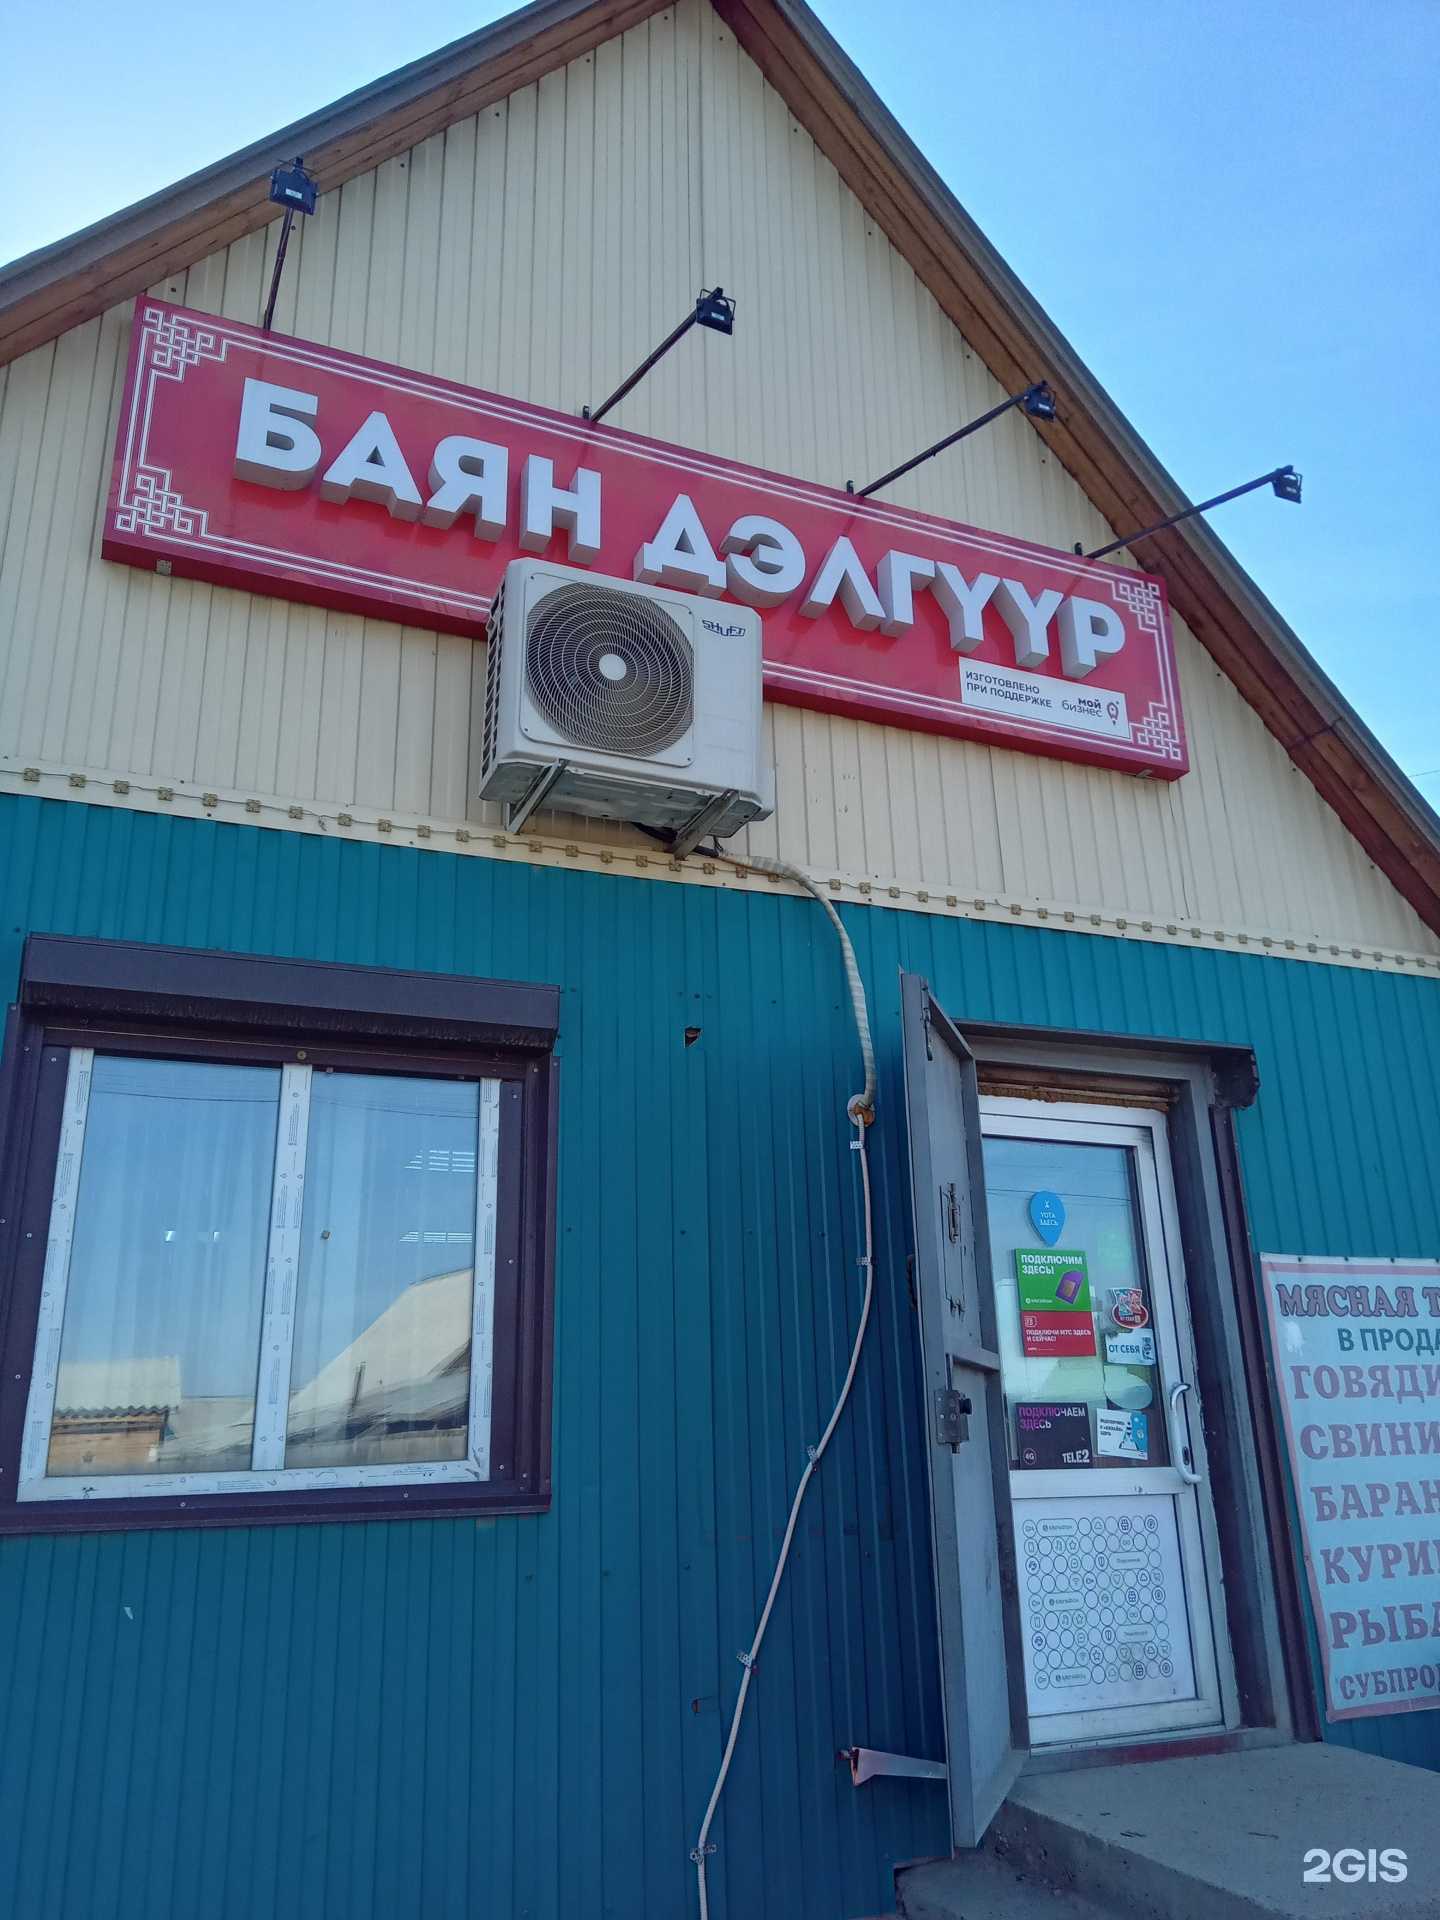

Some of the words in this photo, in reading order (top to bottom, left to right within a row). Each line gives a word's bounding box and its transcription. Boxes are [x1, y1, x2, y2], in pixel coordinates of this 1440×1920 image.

[235, 376, 602, 565] БАЯН
[965, 671, 1040, 694] ИЗГОТОВЛЕНО
[966, 682, 988, 694] ПРИ
[990, 687, 1053, 708] ПОДДЕРЖКЕ
[1078, 697, 1102, 710] мой
[1062, 699, 1103, 718] бизнес
[1021, 1254, 1083, 1265] ПОДКЛЮЧИМ
[1275, 1283, 1419, 1318] МЯСНАЯ
[1108, 1344, 1119, 1353] ОТ
[1121, 1344, 1140, 1354] СЕБЯ
[1338, 1328, 1355, 1351] В
[1360, 1328, 1440, 1356] ПРОД
[1019, 1407, 1086, 1417] ПОДКЛЮЧАЕМ
[1020, 1419, 1052, 1430] ЗДЕСЬ
[1301, 1421, 1440, 1460] СВИНИ
[1062, 1449, 1090, 1463] TELE2
[1320, 1539, 1440, 1585] КУРИ
[1339, 1663, 1440, 1700] СУБПРО
